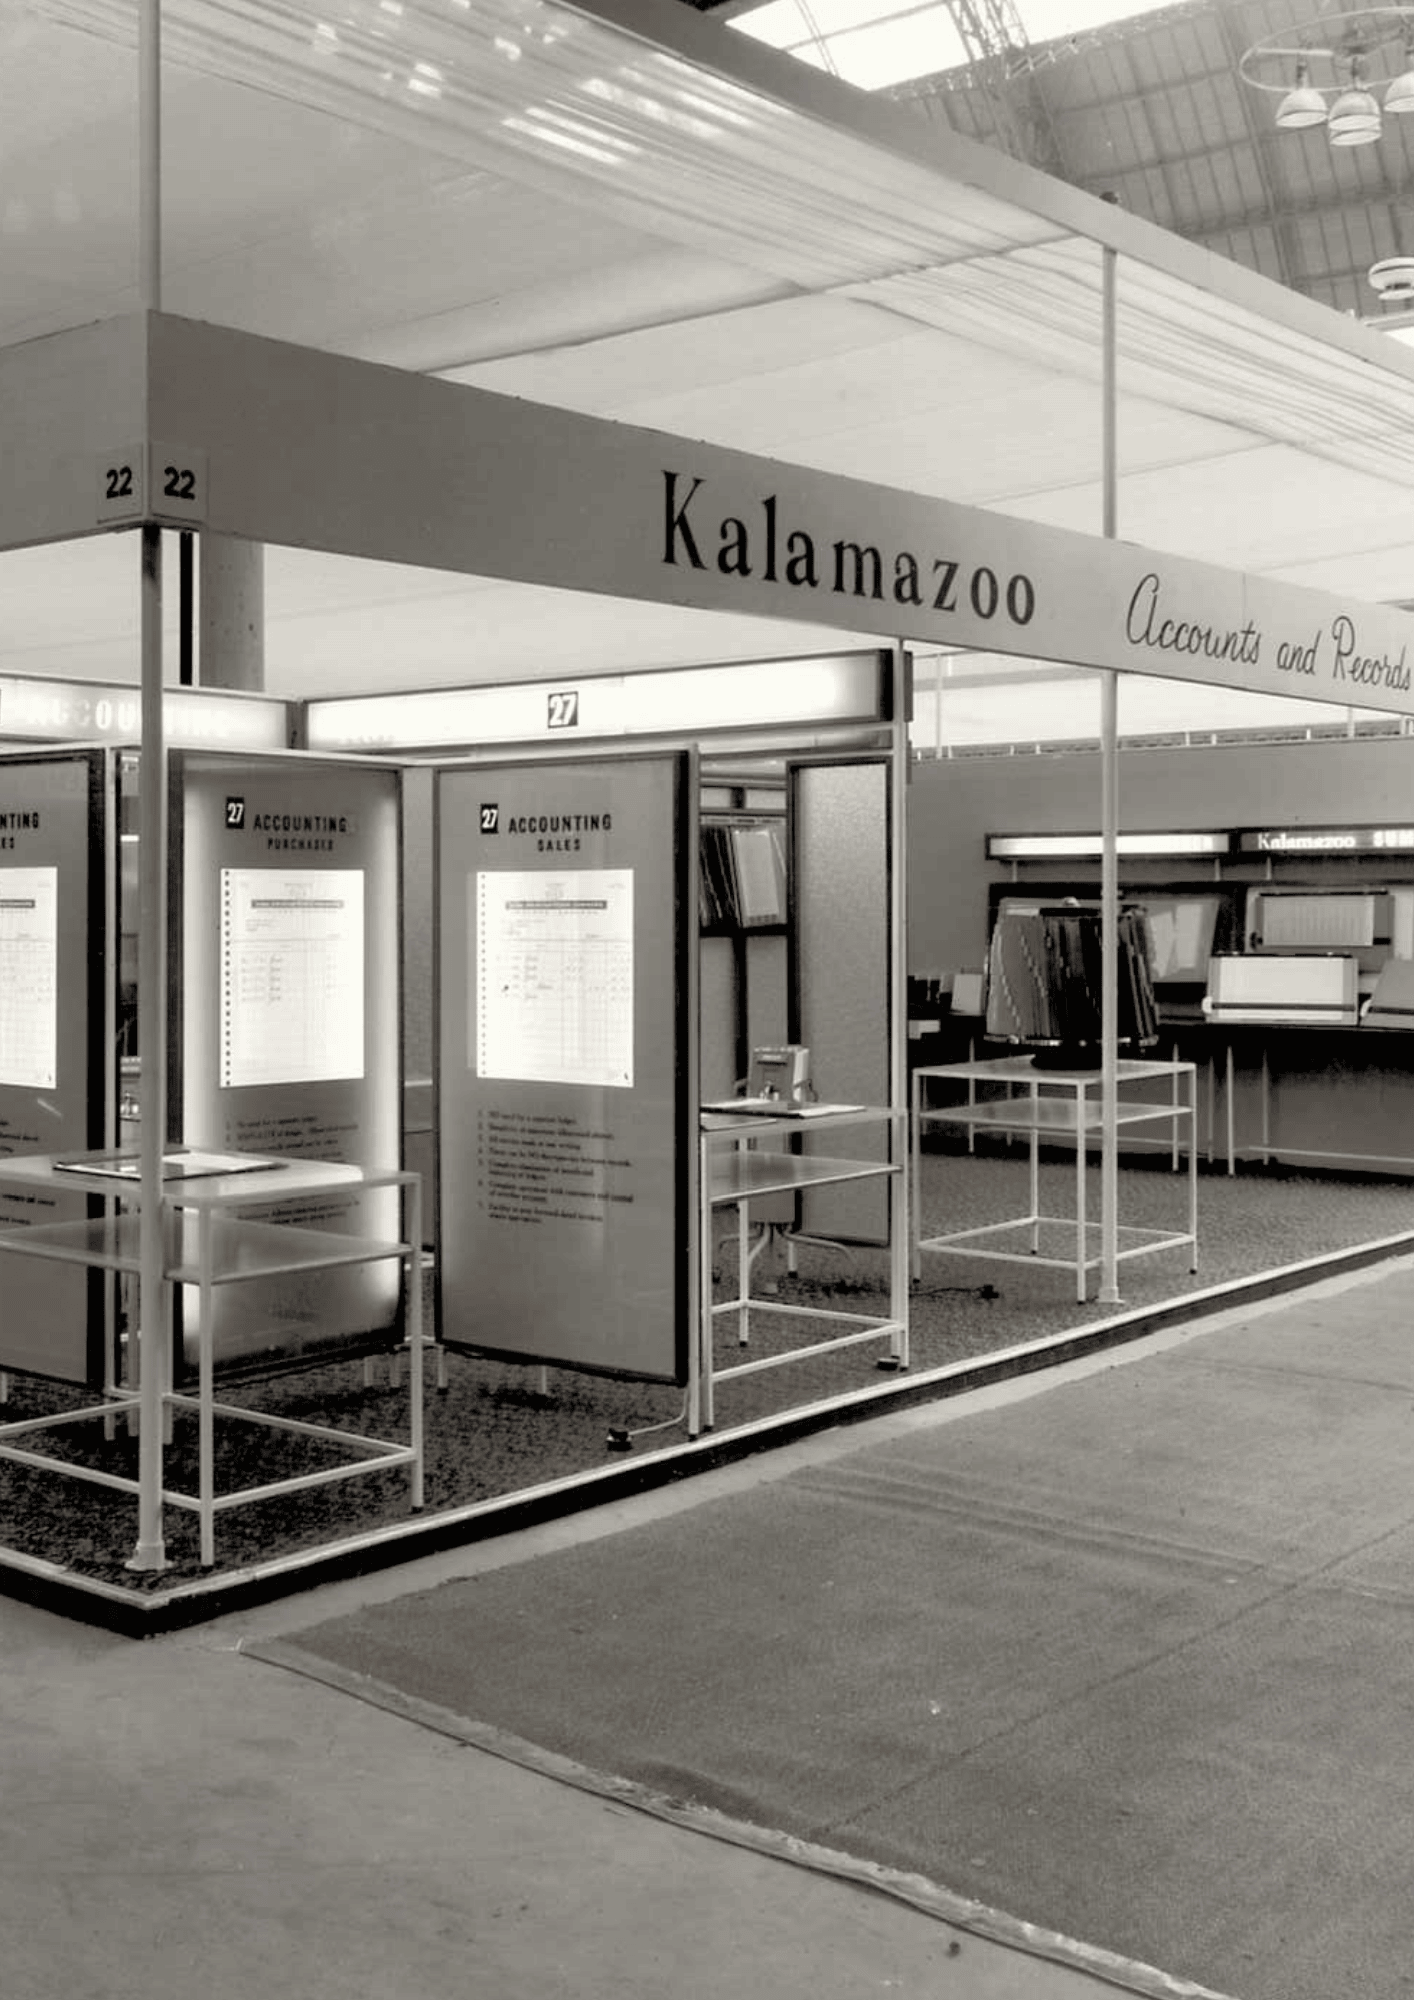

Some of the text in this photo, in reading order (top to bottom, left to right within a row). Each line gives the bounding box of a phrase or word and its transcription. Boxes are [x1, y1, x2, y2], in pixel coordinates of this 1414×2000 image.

[106, 466, 132, 499] 22
[164, 466, 196, 501] 22
[661, 470, 1036, 626] Kalamazoo
[1127, 573, 1412, 691] Accounts and Records
[549, 693, 577, 727] 27
[227, 801, 347, 833] 27 ACCOUNTING
[481, 808, 612, 834] 27 ACCOUNTING
[537, 838, 581, 852] SALES
[1257, 831, 1356, 850] Kalamazoo
